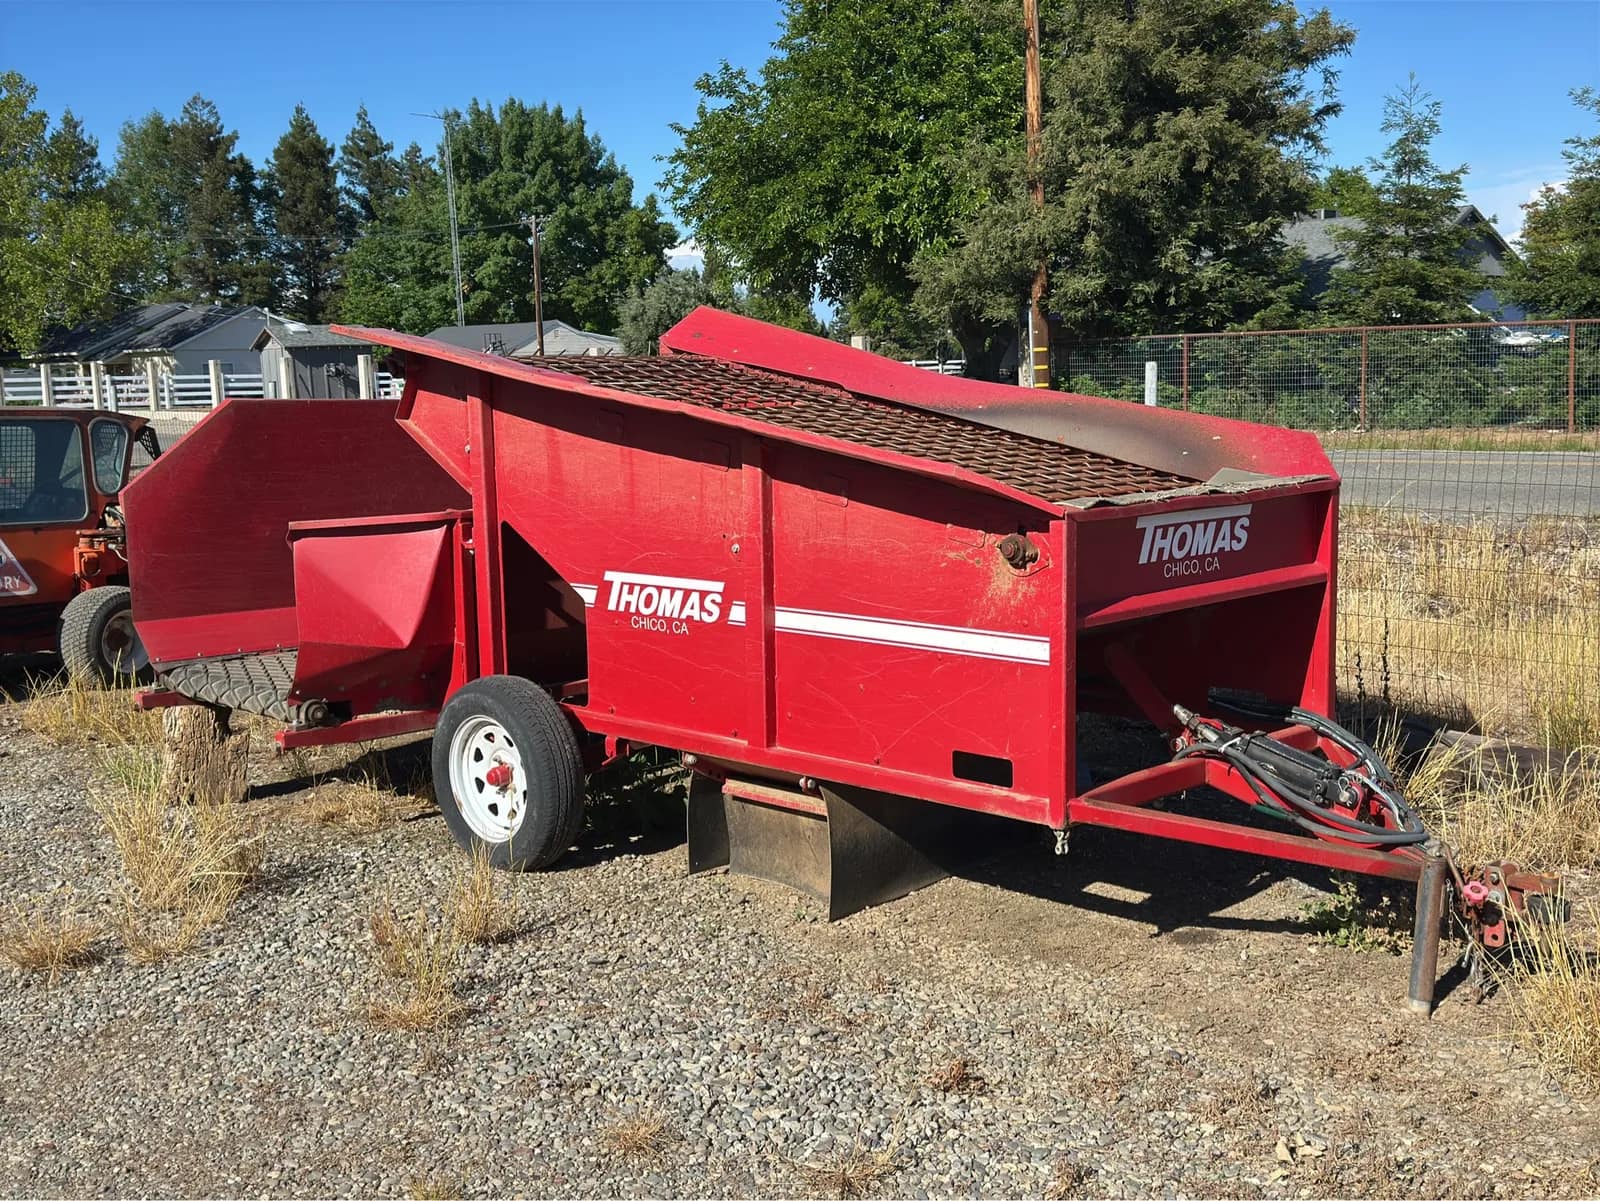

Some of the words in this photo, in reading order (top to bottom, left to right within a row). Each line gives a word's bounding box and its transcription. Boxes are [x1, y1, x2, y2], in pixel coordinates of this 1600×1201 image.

[1136, 504, 1252, 565] THOMAS
[1163, 559, 1202, 578] CHICO,
[1204, 556, 1220, 572] CA
[0, 576, 20, 589] RY
[603, 571, 725, 624] THOMAS
[631, 615, 670, 634] CHICO,
[672, 621, 689, 635] CA
